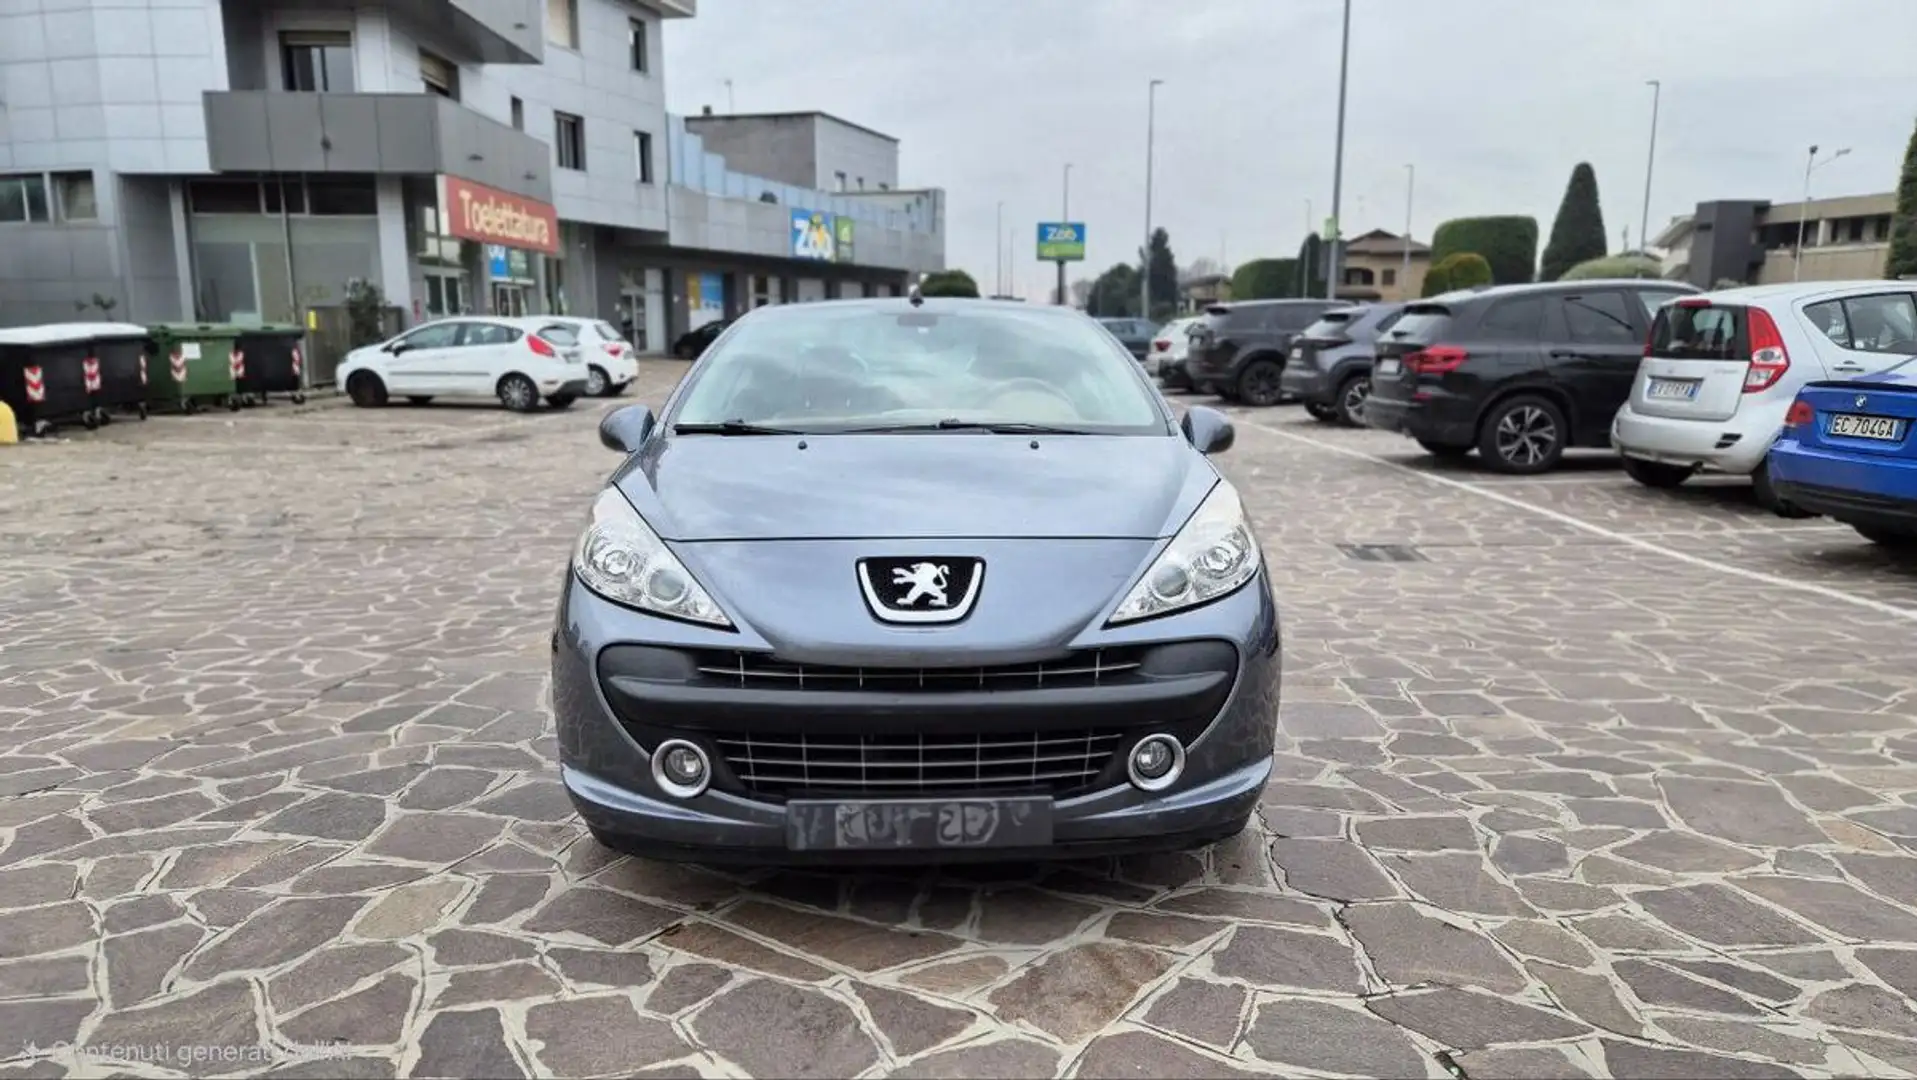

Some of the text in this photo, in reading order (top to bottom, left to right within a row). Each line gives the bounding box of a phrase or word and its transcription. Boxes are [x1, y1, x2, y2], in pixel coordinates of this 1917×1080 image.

[459, 189, 550, 246] Toelettatura
[1833, 416, 1894, 437] EC 704GA
